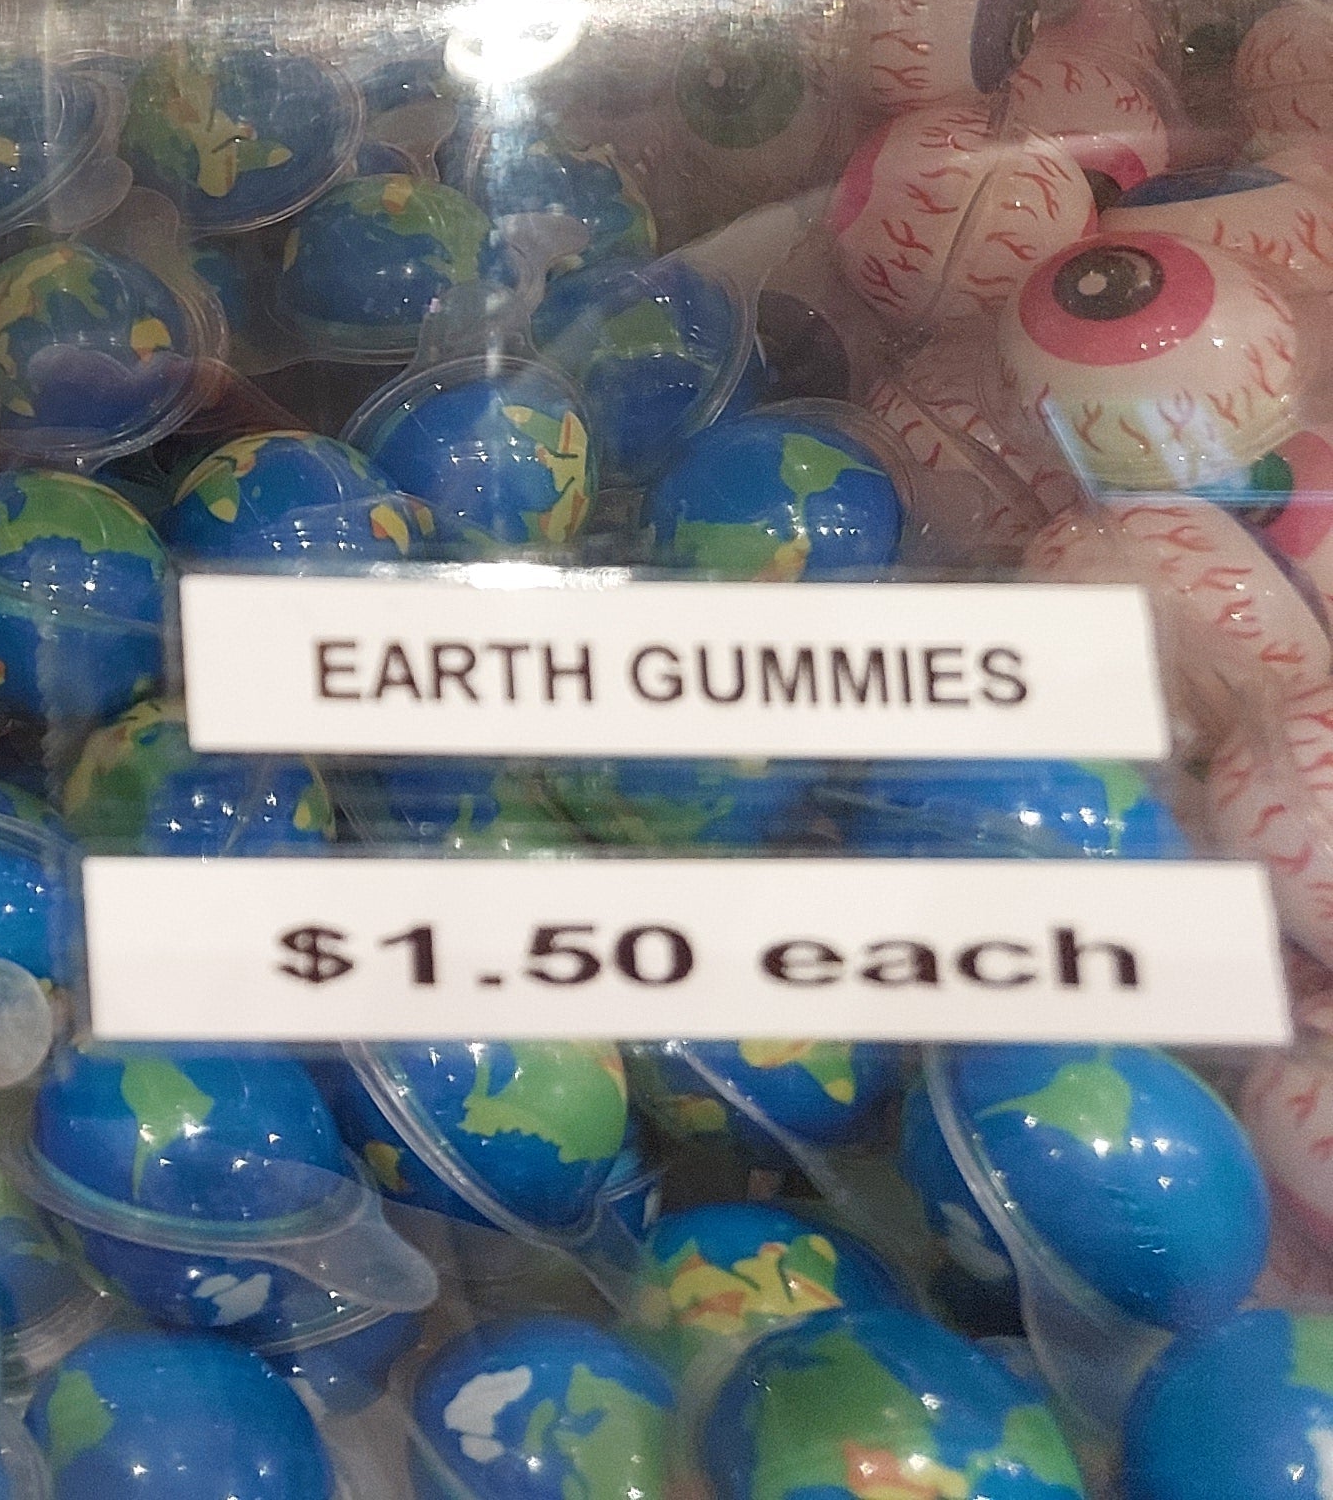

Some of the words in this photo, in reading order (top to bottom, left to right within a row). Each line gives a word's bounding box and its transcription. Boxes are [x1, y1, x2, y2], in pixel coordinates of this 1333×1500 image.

[316, 640, 594, 703] EARTH
[629, 644, 1030, 706] GUMMIES
[277, 923, 695, 988] $1.50
[759, 926, 1141, 990] each
